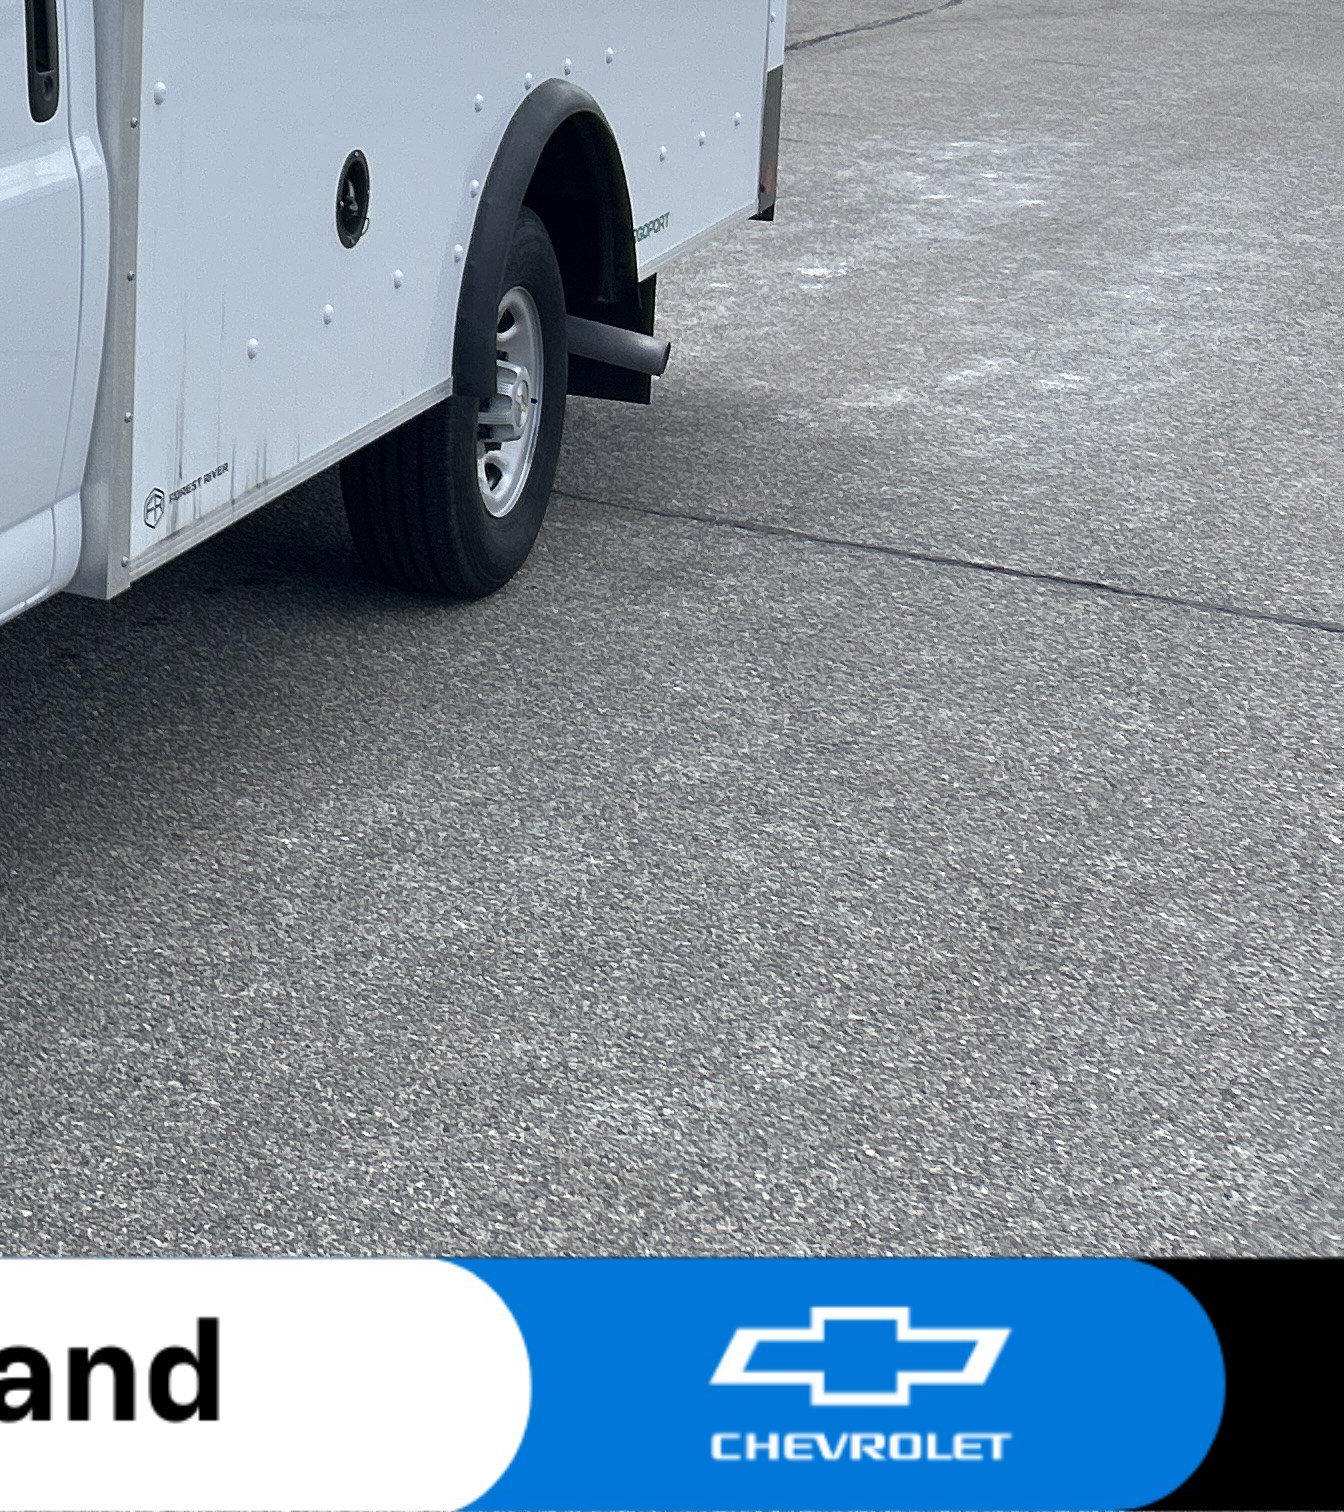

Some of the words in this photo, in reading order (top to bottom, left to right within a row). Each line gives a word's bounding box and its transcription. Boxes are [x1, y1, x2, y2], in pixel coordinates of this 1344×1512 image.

[633, 211, 670, 243] GOPORT
[169, 476, 202, 503] FOREST
[203, 462, 229, 484] RIVER
